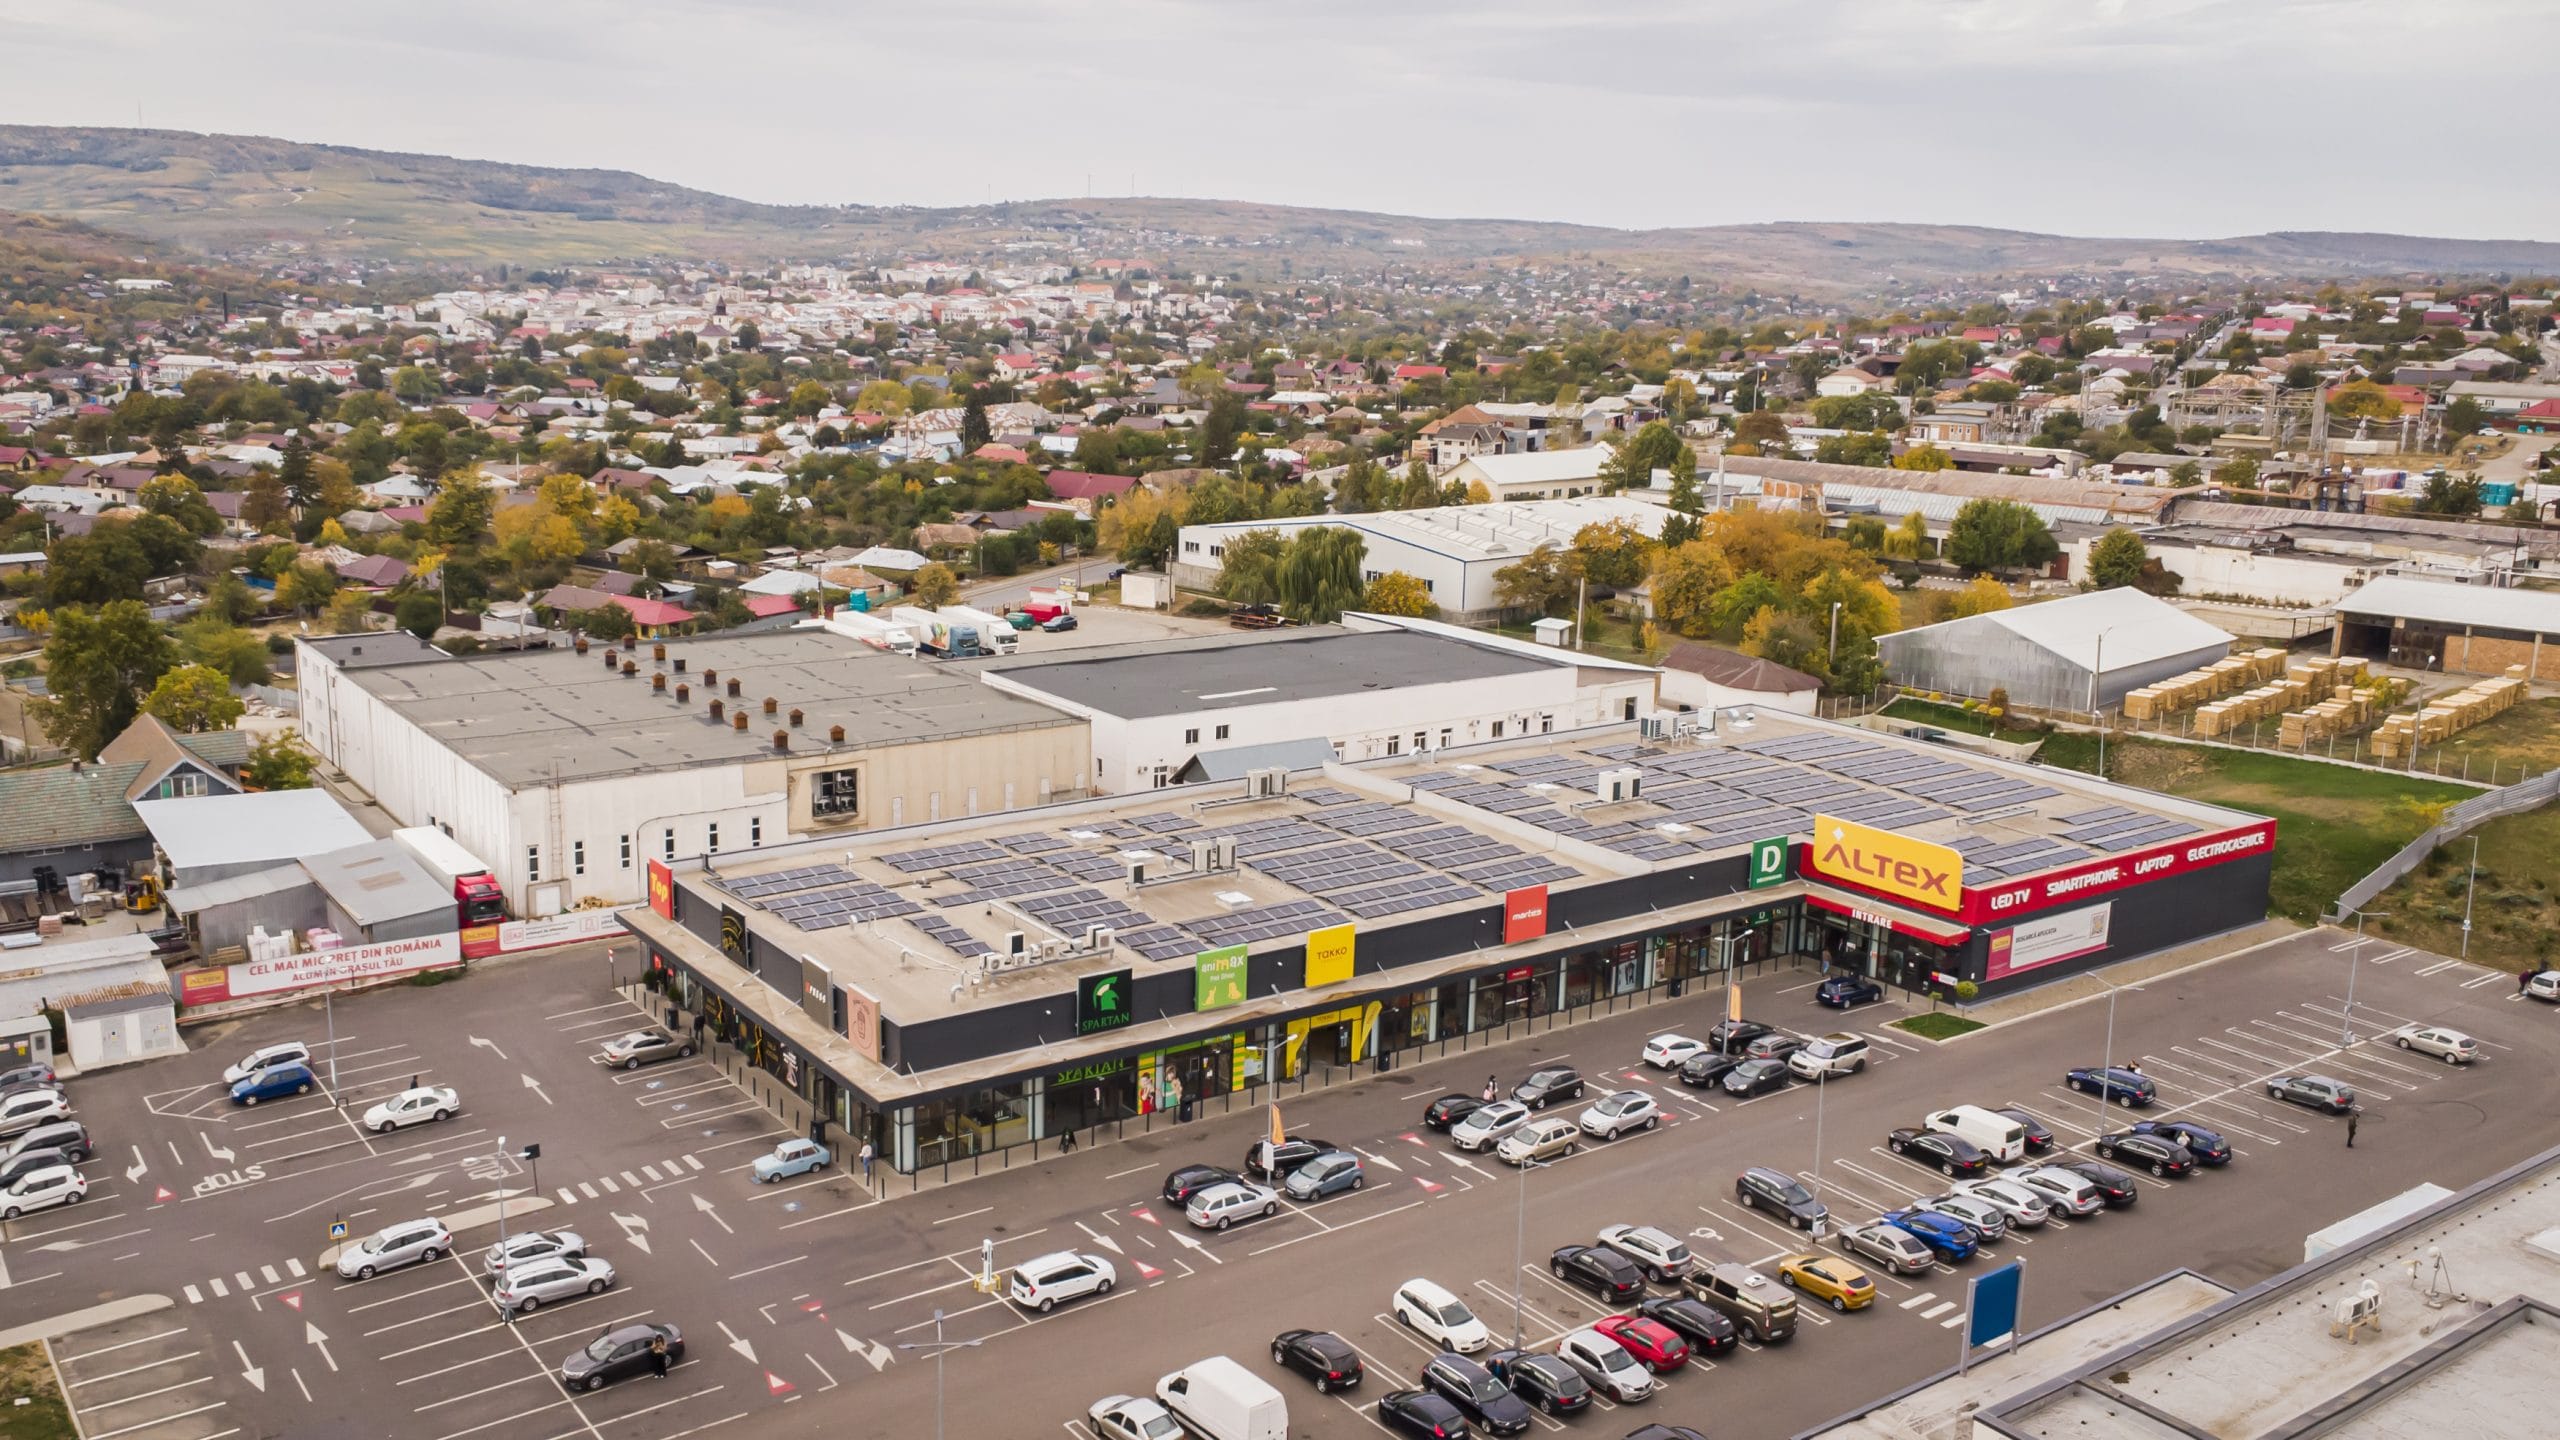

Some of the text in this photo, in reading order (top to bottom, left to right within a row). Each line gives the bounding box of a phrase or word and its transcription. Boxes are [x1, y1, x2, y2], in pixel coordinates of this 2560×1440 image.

[1761, 845, 1781, 873] D
[650, 872, 668, 902] Top
[1990, 893, 2013, 910] LED
[2013, 888, 2031, 906] TV
[2047, 867, 2119, 896] SMARTPHONE
[2134, 854, 2175, 875] LAPTOP
[1512, 908, 1542, 920] martes
[1852, 909, 1892, 929] INTRARE
[249, 964, 270, 976] CEL
[274, 960, 298, 972] MAI
[302, 955, 324, 968] MIC
[361, 947, 382, 959] DIN
[385, 938, 442, 956] ROMÂNIA
[383, 957, 403, 969] TĂU
[1201, 955, 1245, 973] animax
[1082, 1012, 1130, 1031] SPARTAN
[194, 1165, 267, 1193] STOP
